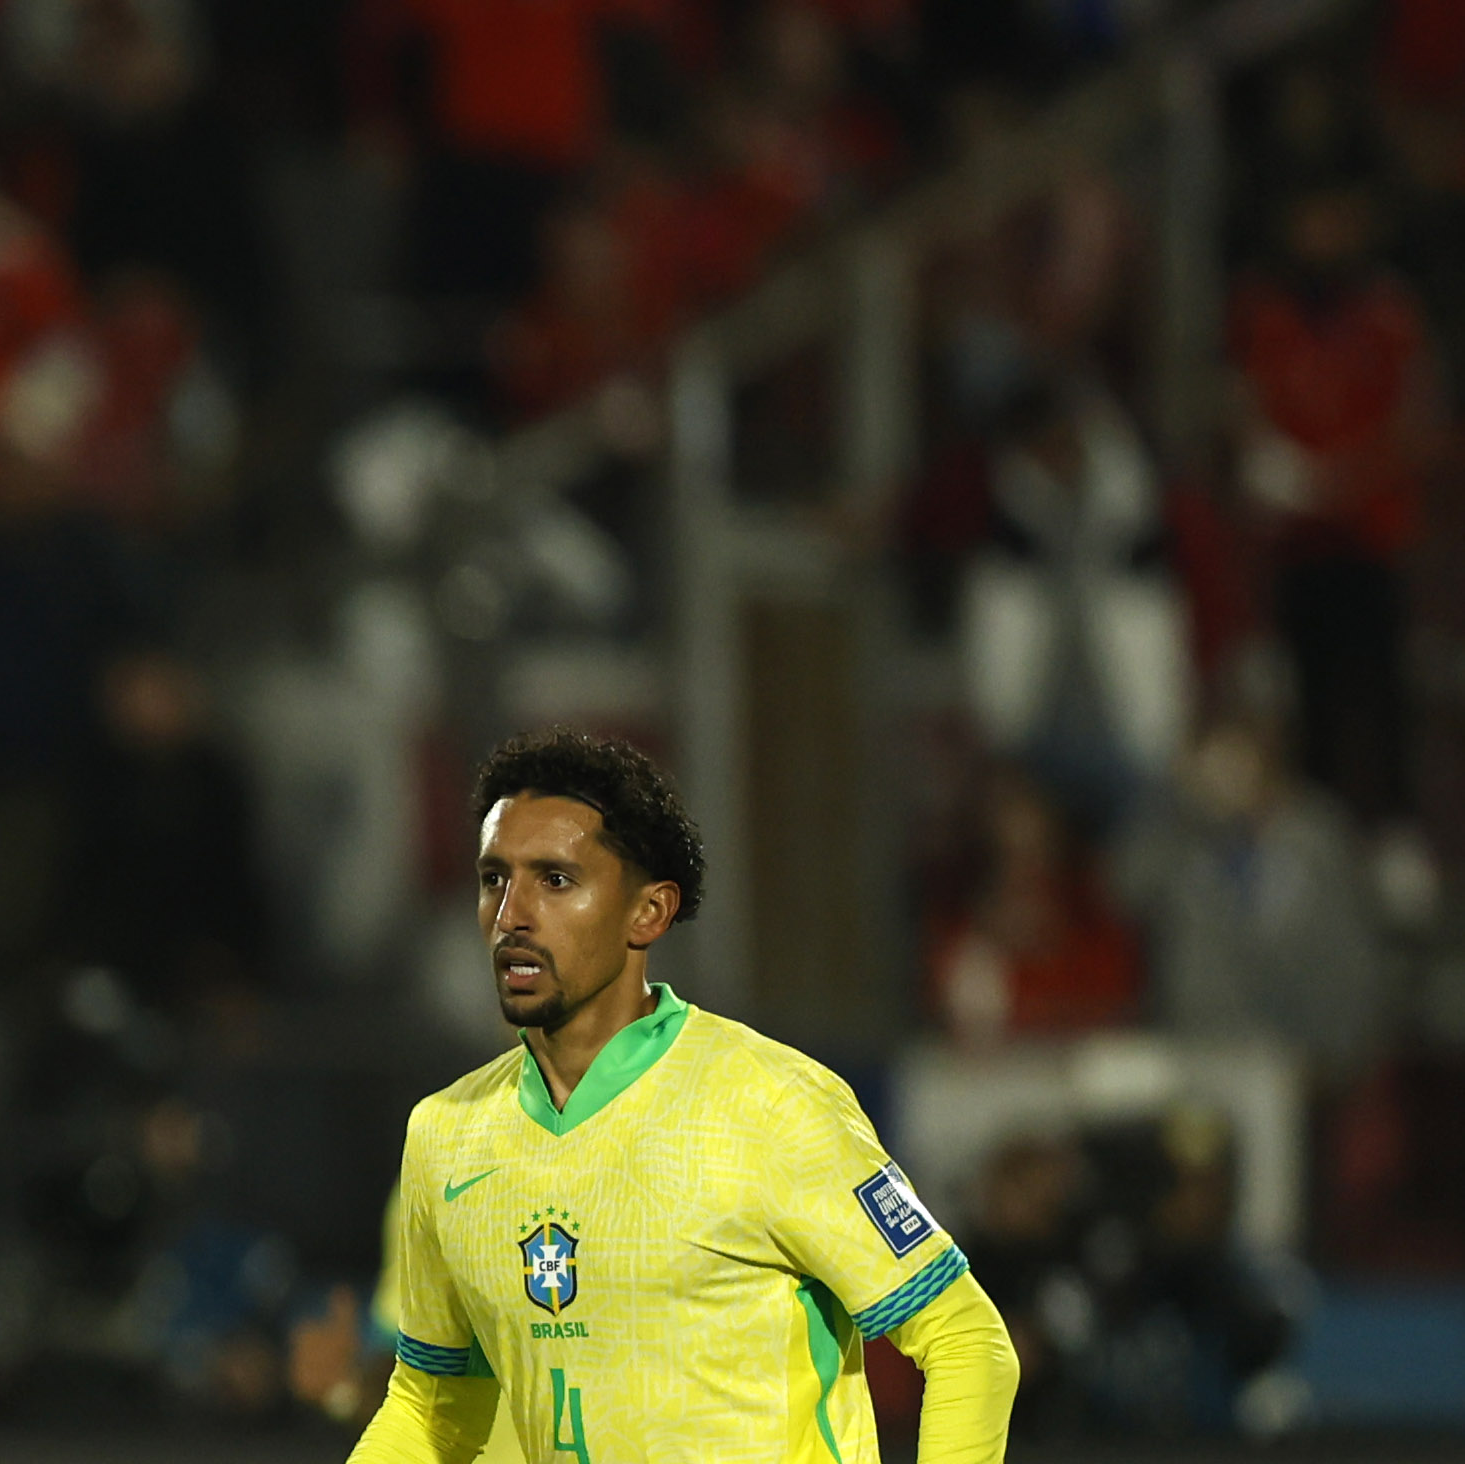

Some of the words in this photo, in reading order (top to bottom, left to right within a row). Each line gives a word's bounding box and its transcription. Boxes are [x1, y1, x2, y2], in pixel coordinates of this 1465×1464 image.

[904, 1219, 919, 1231] FIFA
[539, 1260, 561, 1272] CBF
[530, 1322, 589, 1339] BRASIL
